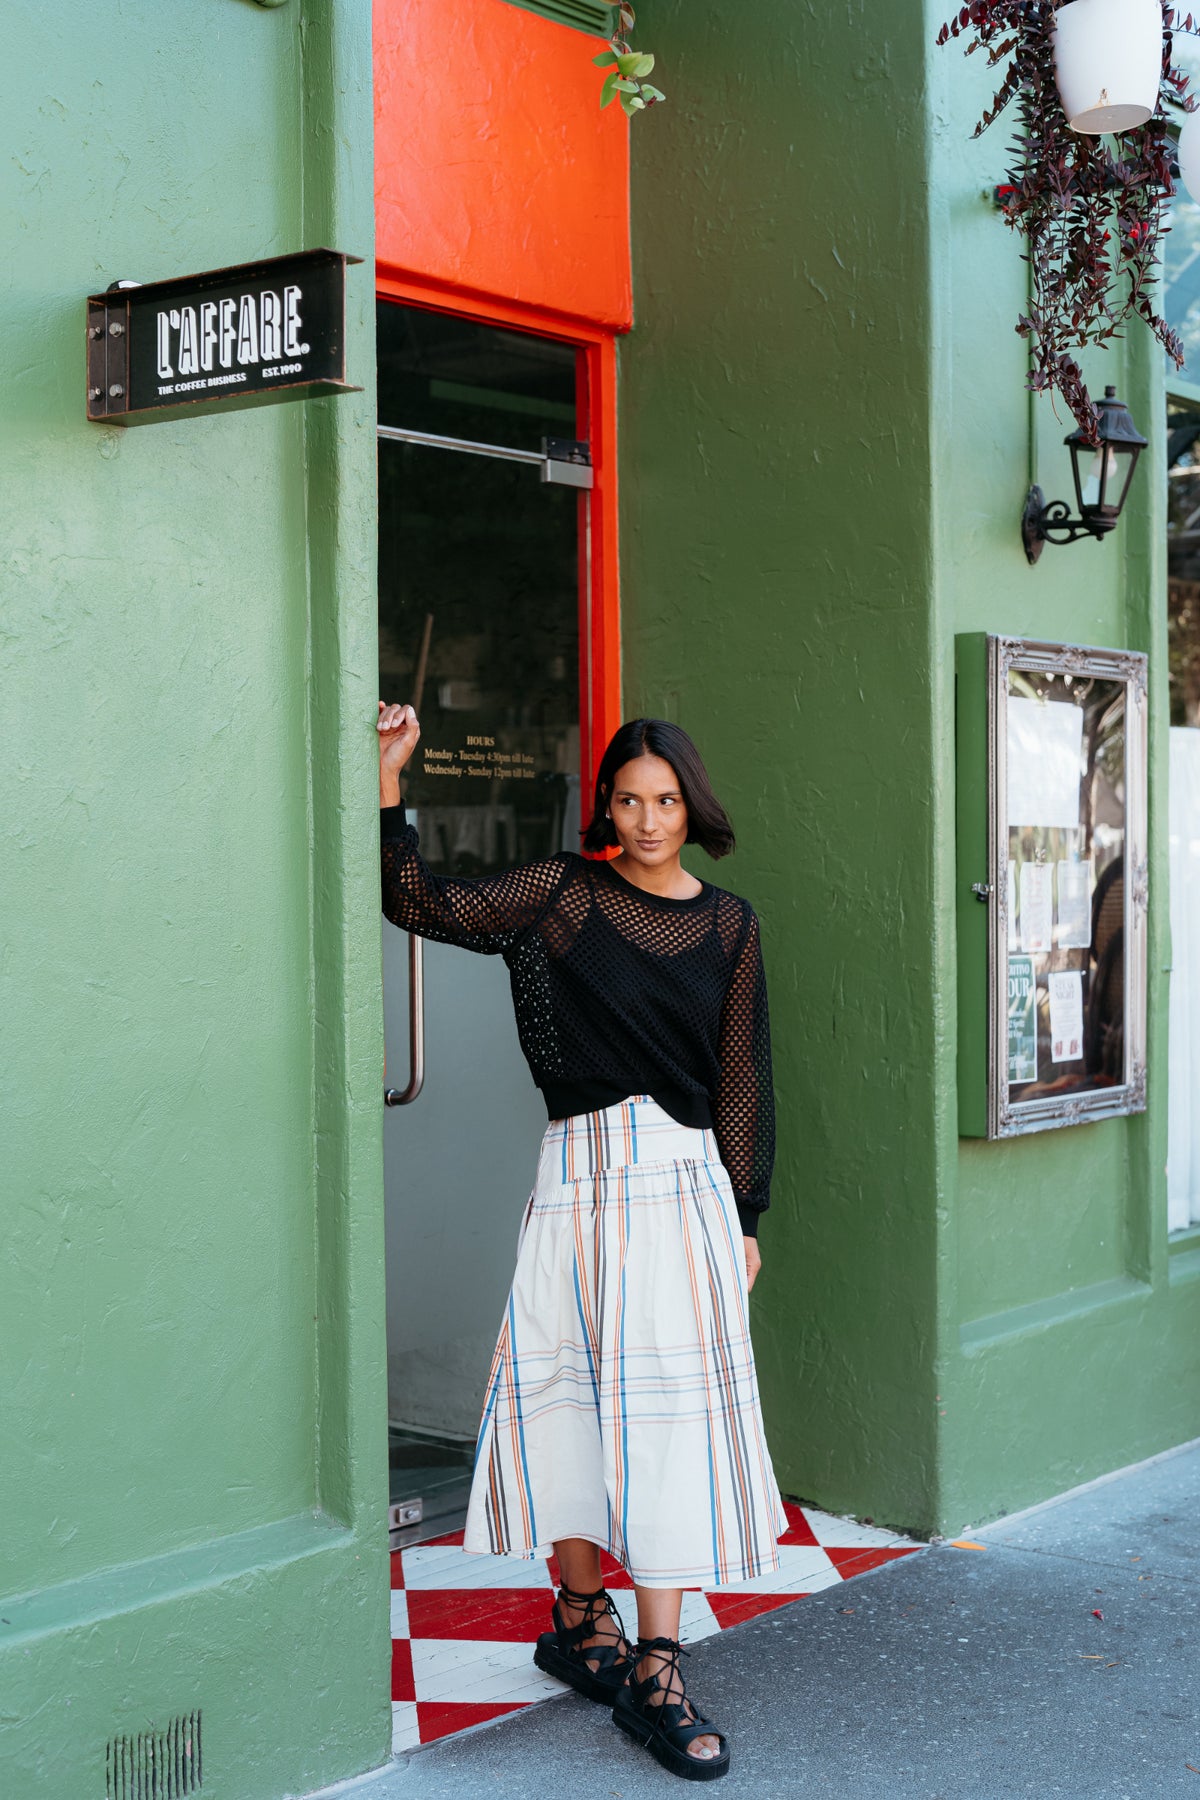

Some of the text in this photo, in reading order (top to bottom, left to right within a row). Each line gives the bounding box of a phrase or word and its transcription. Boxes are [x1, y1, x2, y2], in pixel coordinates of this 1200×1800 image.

[158, 386, 174, 395] THE
[175, 379, 206, 392] COFFEE
[207, 372, 247, 387] BUSINESS
[467, 736, 495, 747] HOURS
[424, 748, 453, 762] Monday
[459, 750, 485, 764] Tuesday
[486, 752, 511, 764] 4:30pm
[512, 753, 521, 763] till
[522, 753, 534, 764] late
[424, 763, 463, 778] Wednesday
[468, 765, 492, 779] Sunday
[494, 767, 512, 780] 12pm
[512, 768, 522, 778] till
[523, 768, 535, 778] late
